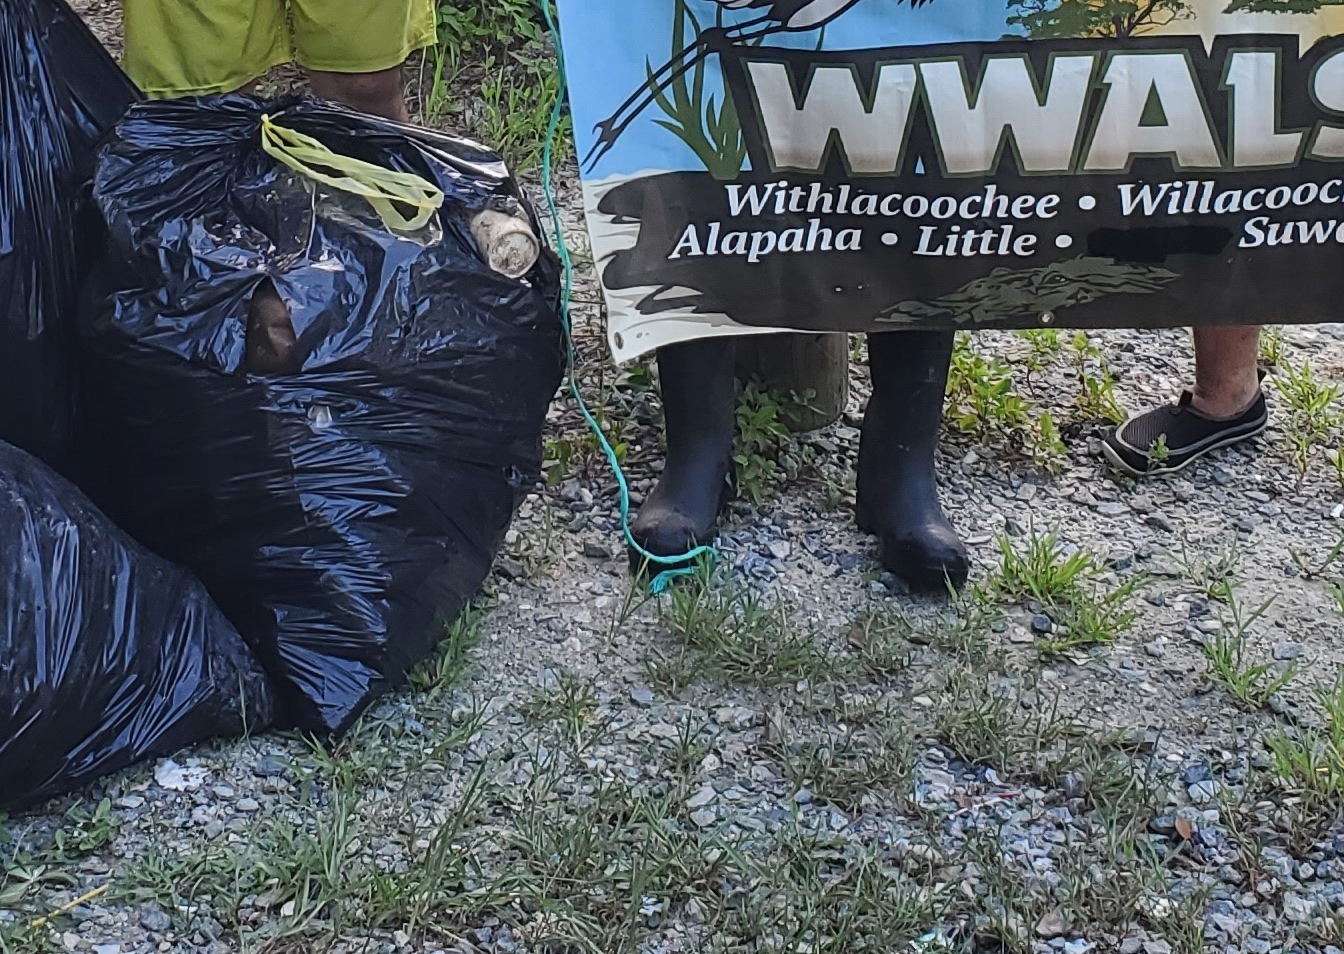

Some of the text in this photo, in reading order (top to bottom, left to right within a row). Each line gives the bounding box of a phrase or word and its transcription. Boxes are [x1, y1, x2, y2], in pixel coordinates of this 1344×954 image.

[724, 180, 1060, 219] Withlacoochee
[668, 219, 862, 263] Alapaha
[912, 224, 1038, 257] Little
